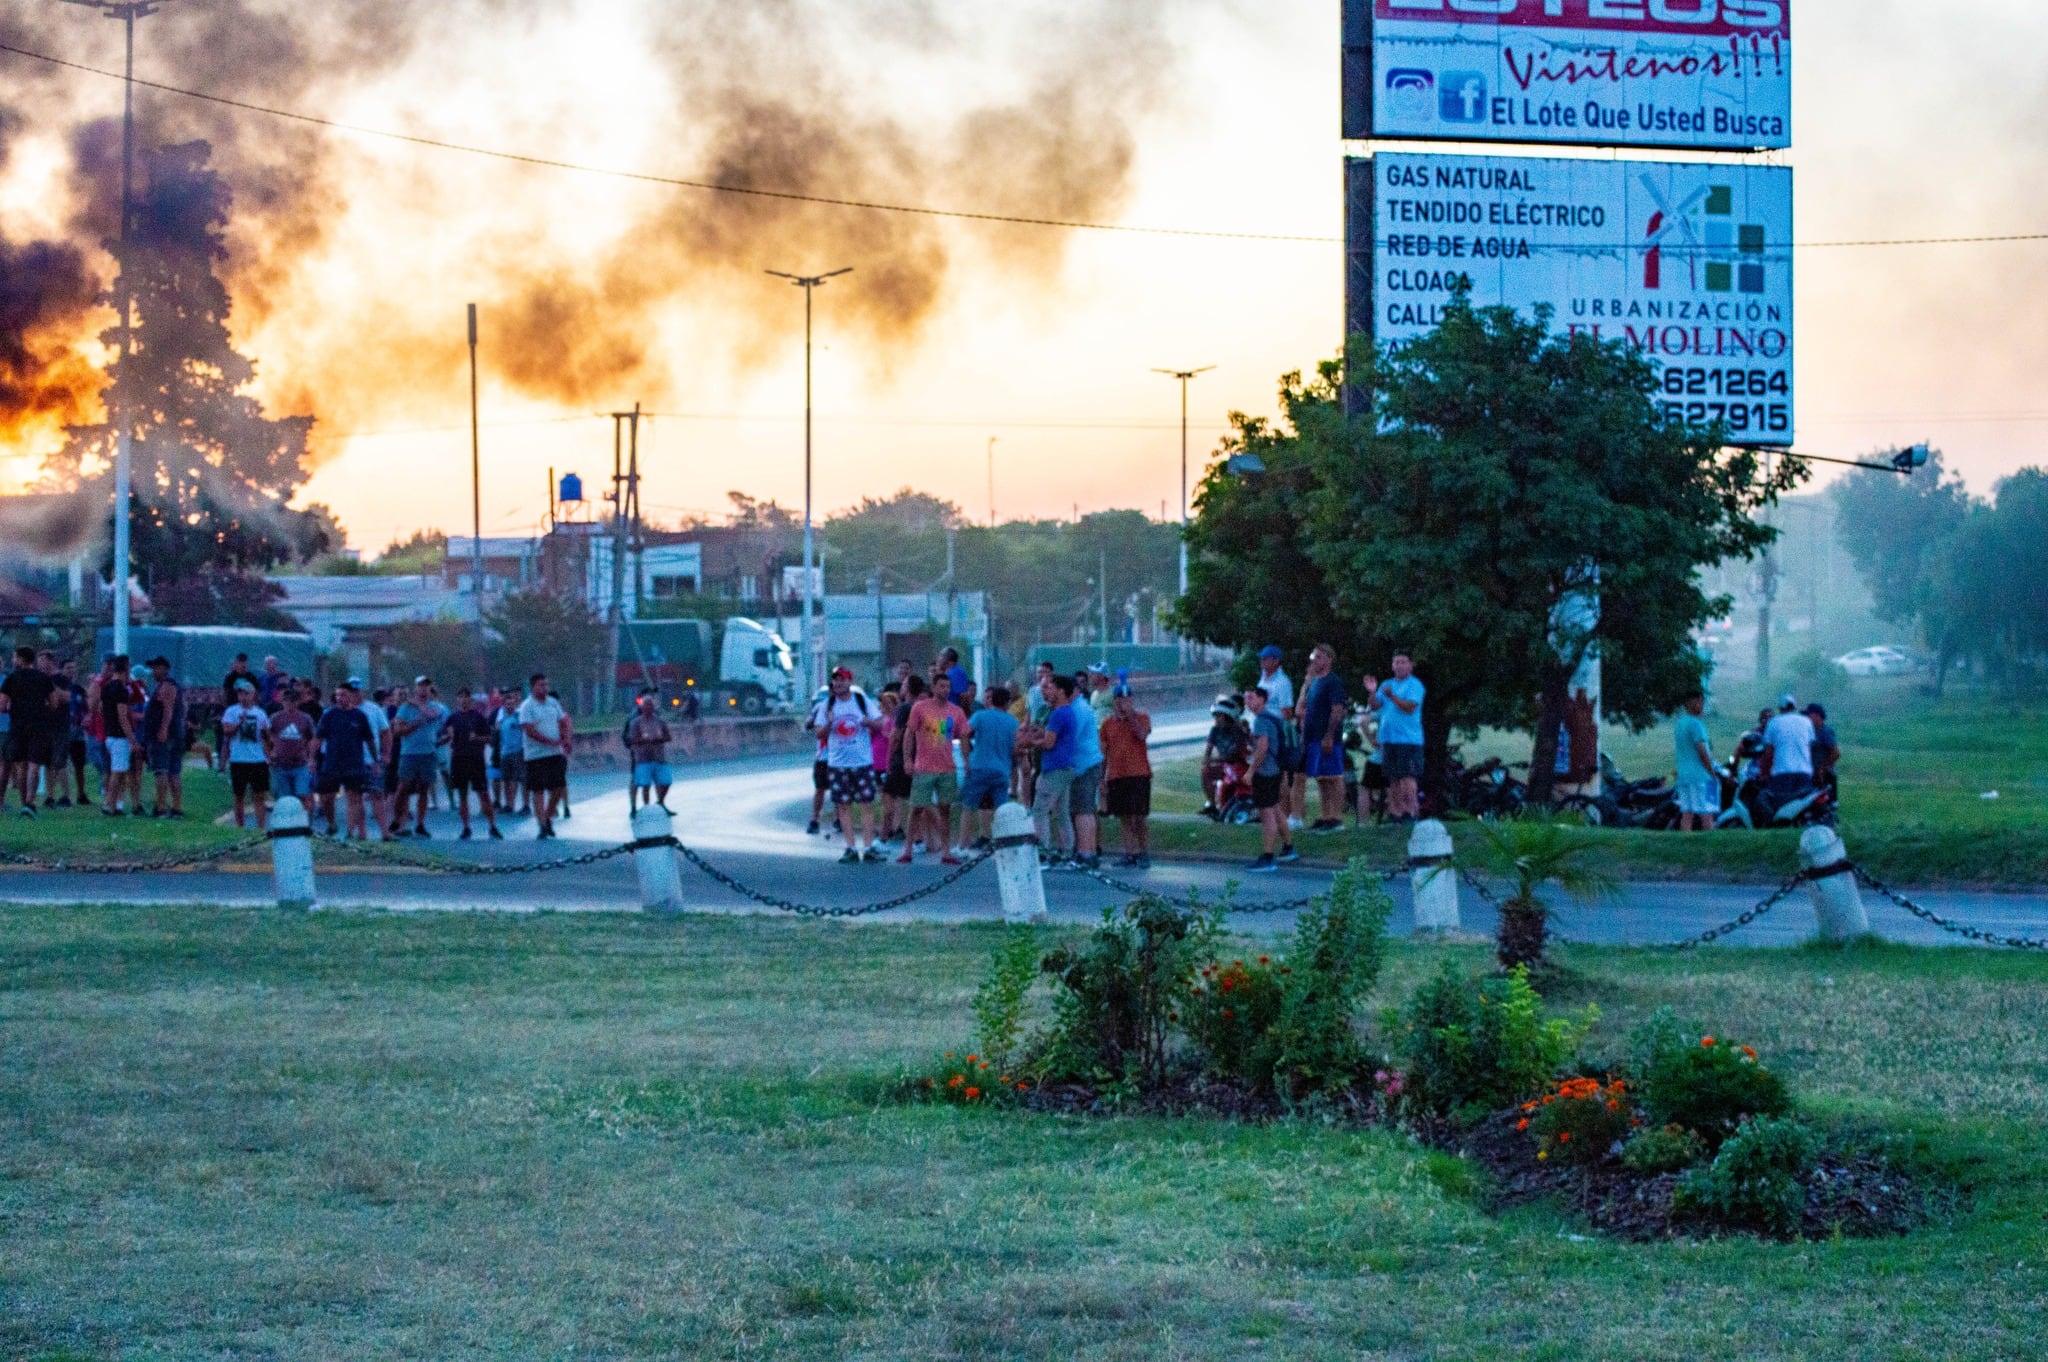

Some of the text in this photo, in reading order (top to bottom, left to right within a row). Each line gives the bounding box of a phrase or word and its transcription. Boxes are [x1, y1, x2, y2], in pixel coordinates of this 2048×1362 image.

[1388, 0, 1782, 27] EOS
[1491, 97, 1783, 136] El Lote Que Usted Busca
[1386, 165, 1536, 191] GAS NATURAL
[1387, 197, 1605, 227] TENDIDO ELÉCTRICO
[1387, 234, 1530, 260] RED DE AGUA
[1387, 269, 1472, 292] CLOACA
[1387, 303, 1443, 325] CALL
[1572, 297, 1781, 322] URBANIZACIÓN
[1622, 324, 1787, 358] MOLINO
[1664, 367, 1788, 396] 621264
[1665, 401, 1788, 431] 627915
